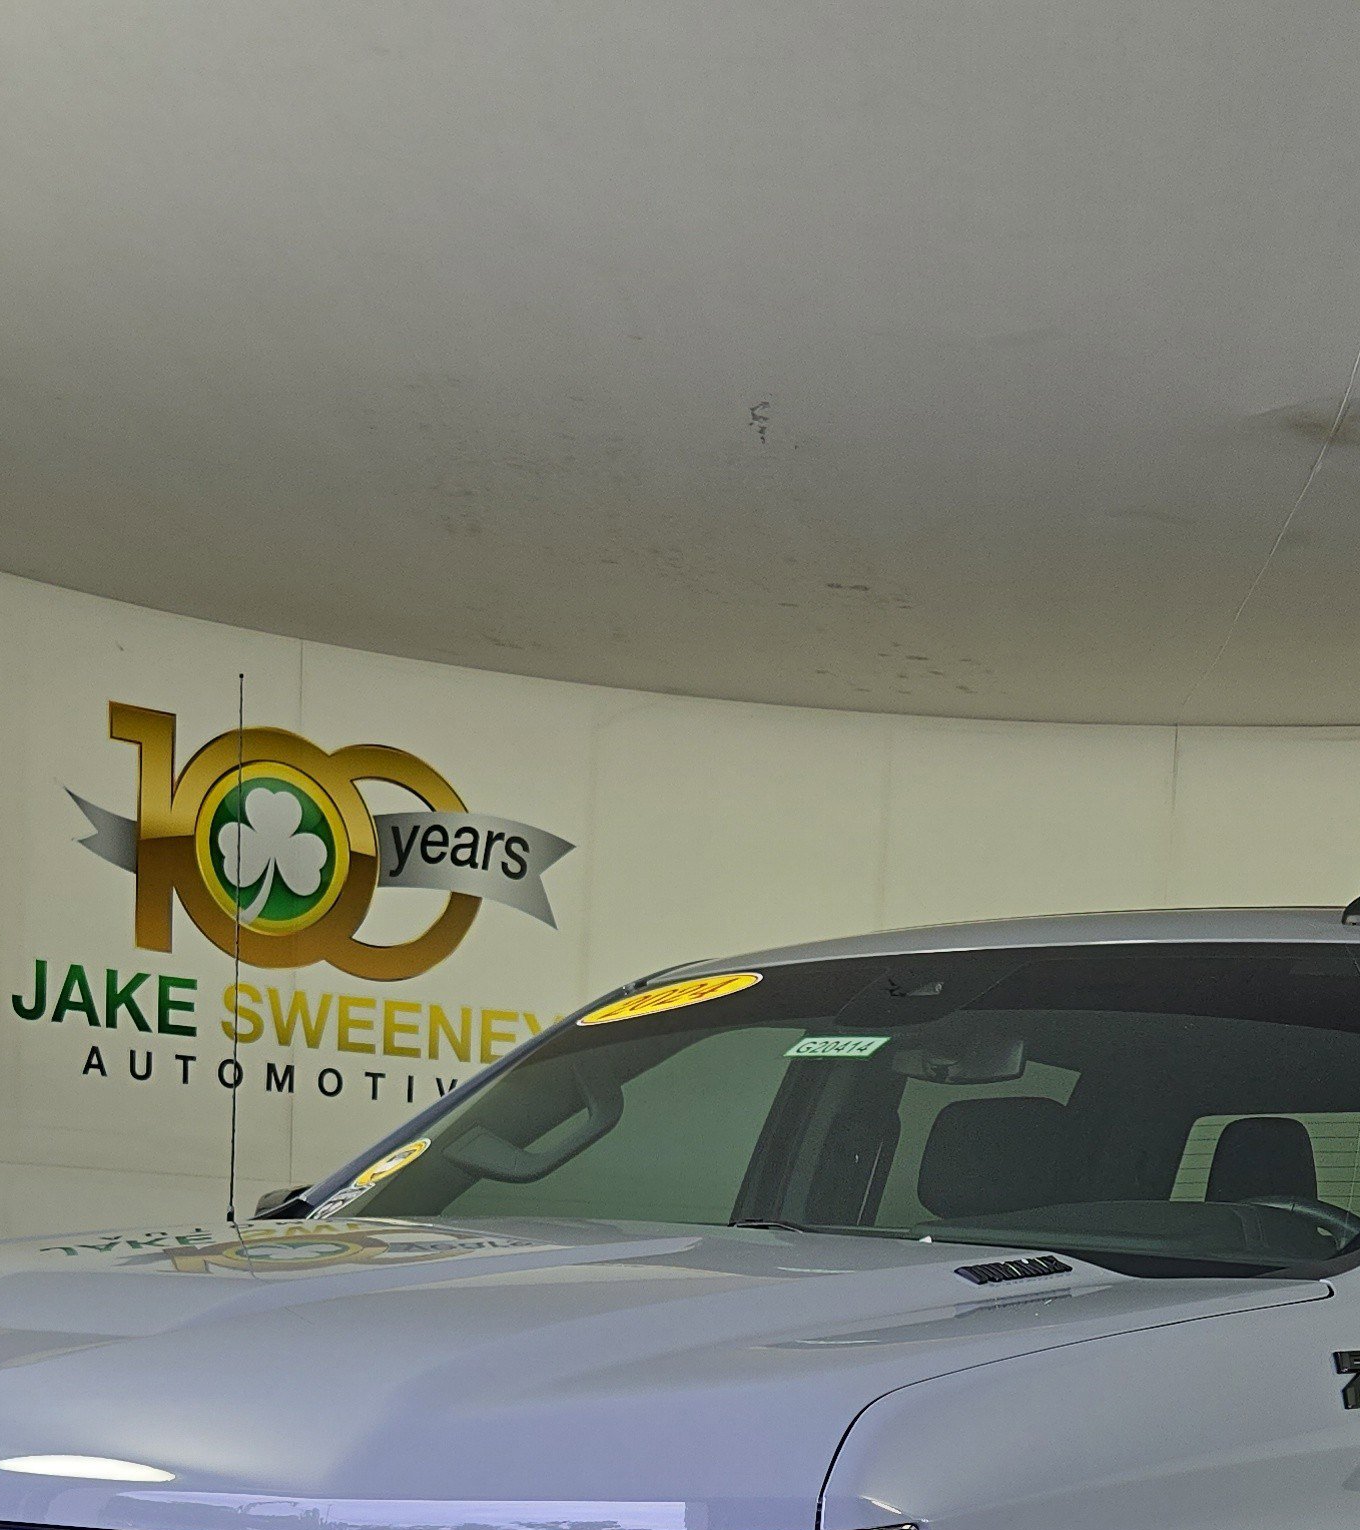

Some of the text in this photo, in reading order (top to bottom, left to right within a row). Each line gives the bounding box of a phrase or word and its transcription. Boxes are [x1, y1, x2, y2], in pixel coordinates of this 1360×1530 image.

[108, 701, 531, 982] 100 years
[11, 959, 198, 1037] JAKE
[82, 1045, 459, 1103] AUTOMOTIV
[796, 1039, 877, 1055] G20414
